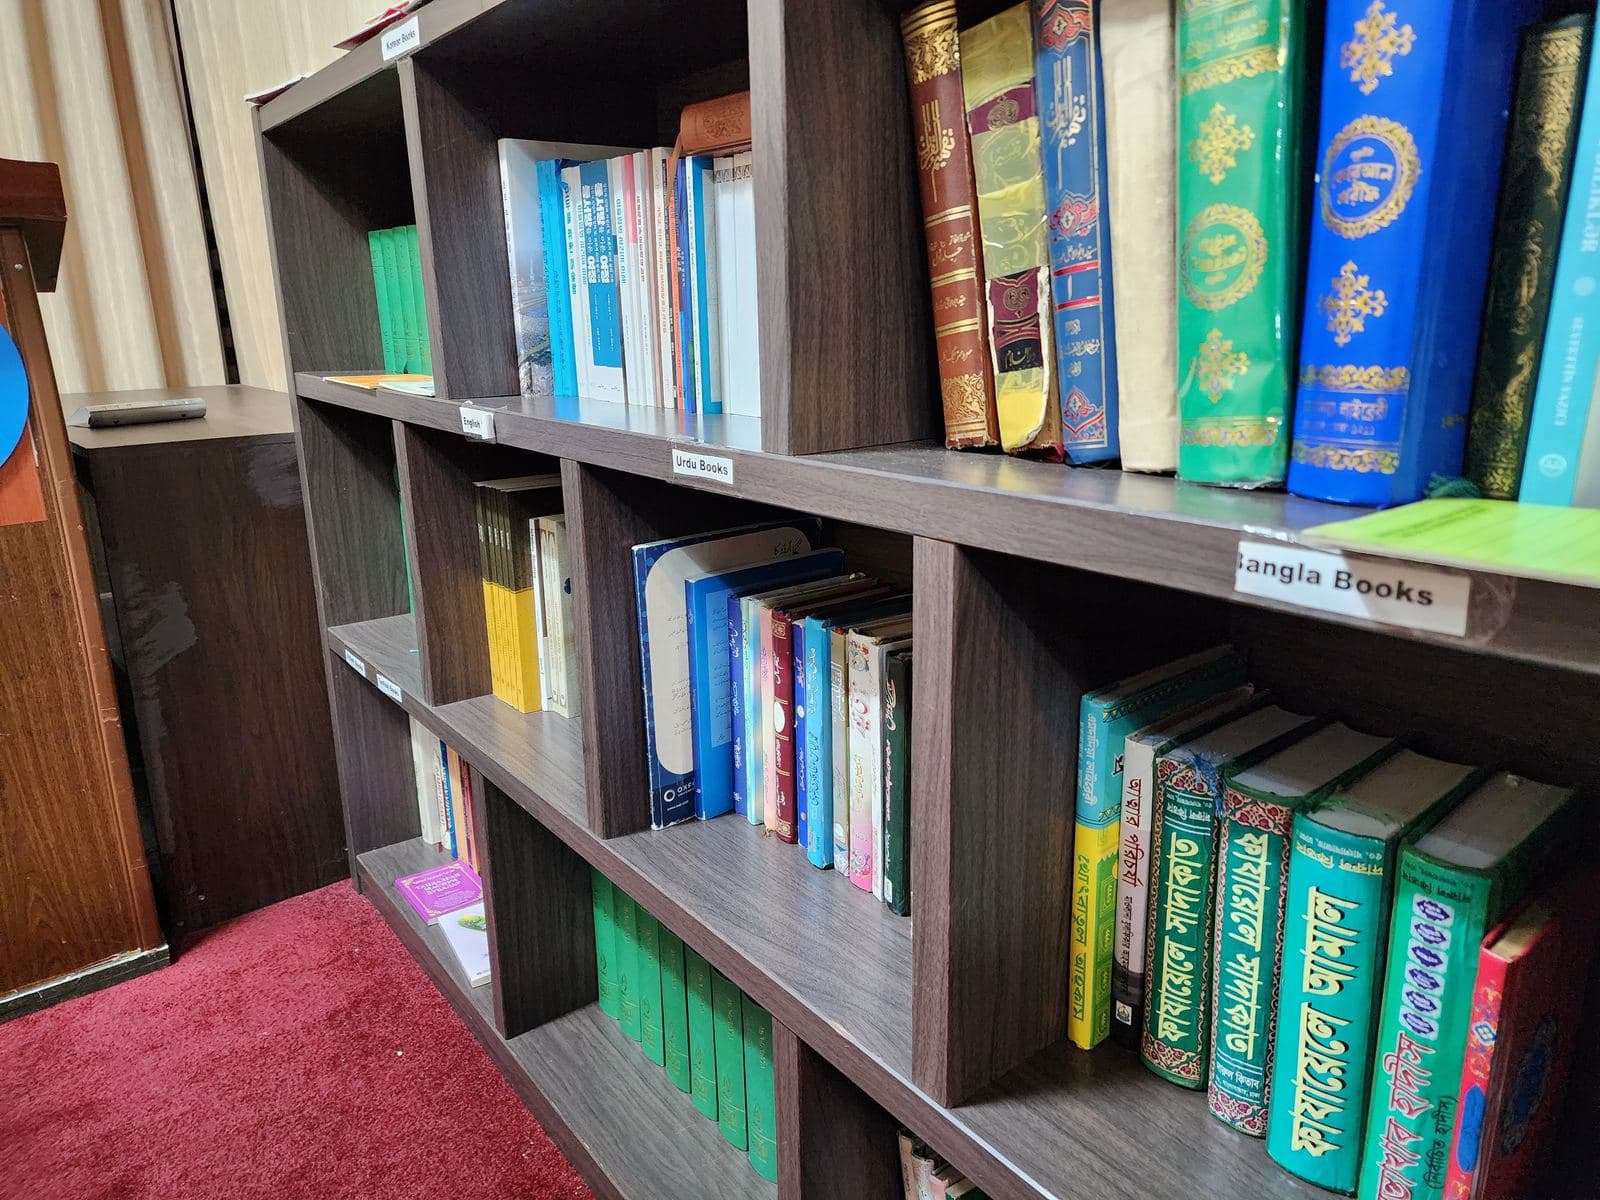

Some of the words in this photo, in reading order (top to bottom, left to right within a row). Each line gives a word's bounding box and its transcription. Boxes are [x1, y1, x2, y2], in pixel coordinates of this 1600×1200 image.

[402, 31, 415, 43] Books
[676, 455, 697, 469] Urdu
[699, 460, 729, 476] Books
[1334, 569, 1434, 607] Books
[1125, 778, 1143, 828] আত্মার
[1121, 833, 1145, 888] পরিচর্যা
[1164, 832, 1204, 934] সাদাকাত
[1299, 886, 1362, 996] আমাল
[1072, 952, 1087, 1022] আহকাম
[1222, 953, 1261, 1060] সাদাকাত
[1291, 1002, 1353, 1157] ফাযায়েলে
[1383, 1031, 1436, 1118] হাদীস
[1432, 1096, 1457, 1136] হাদীস)
[1375, 1117, 1424, 1200] তাখাব
